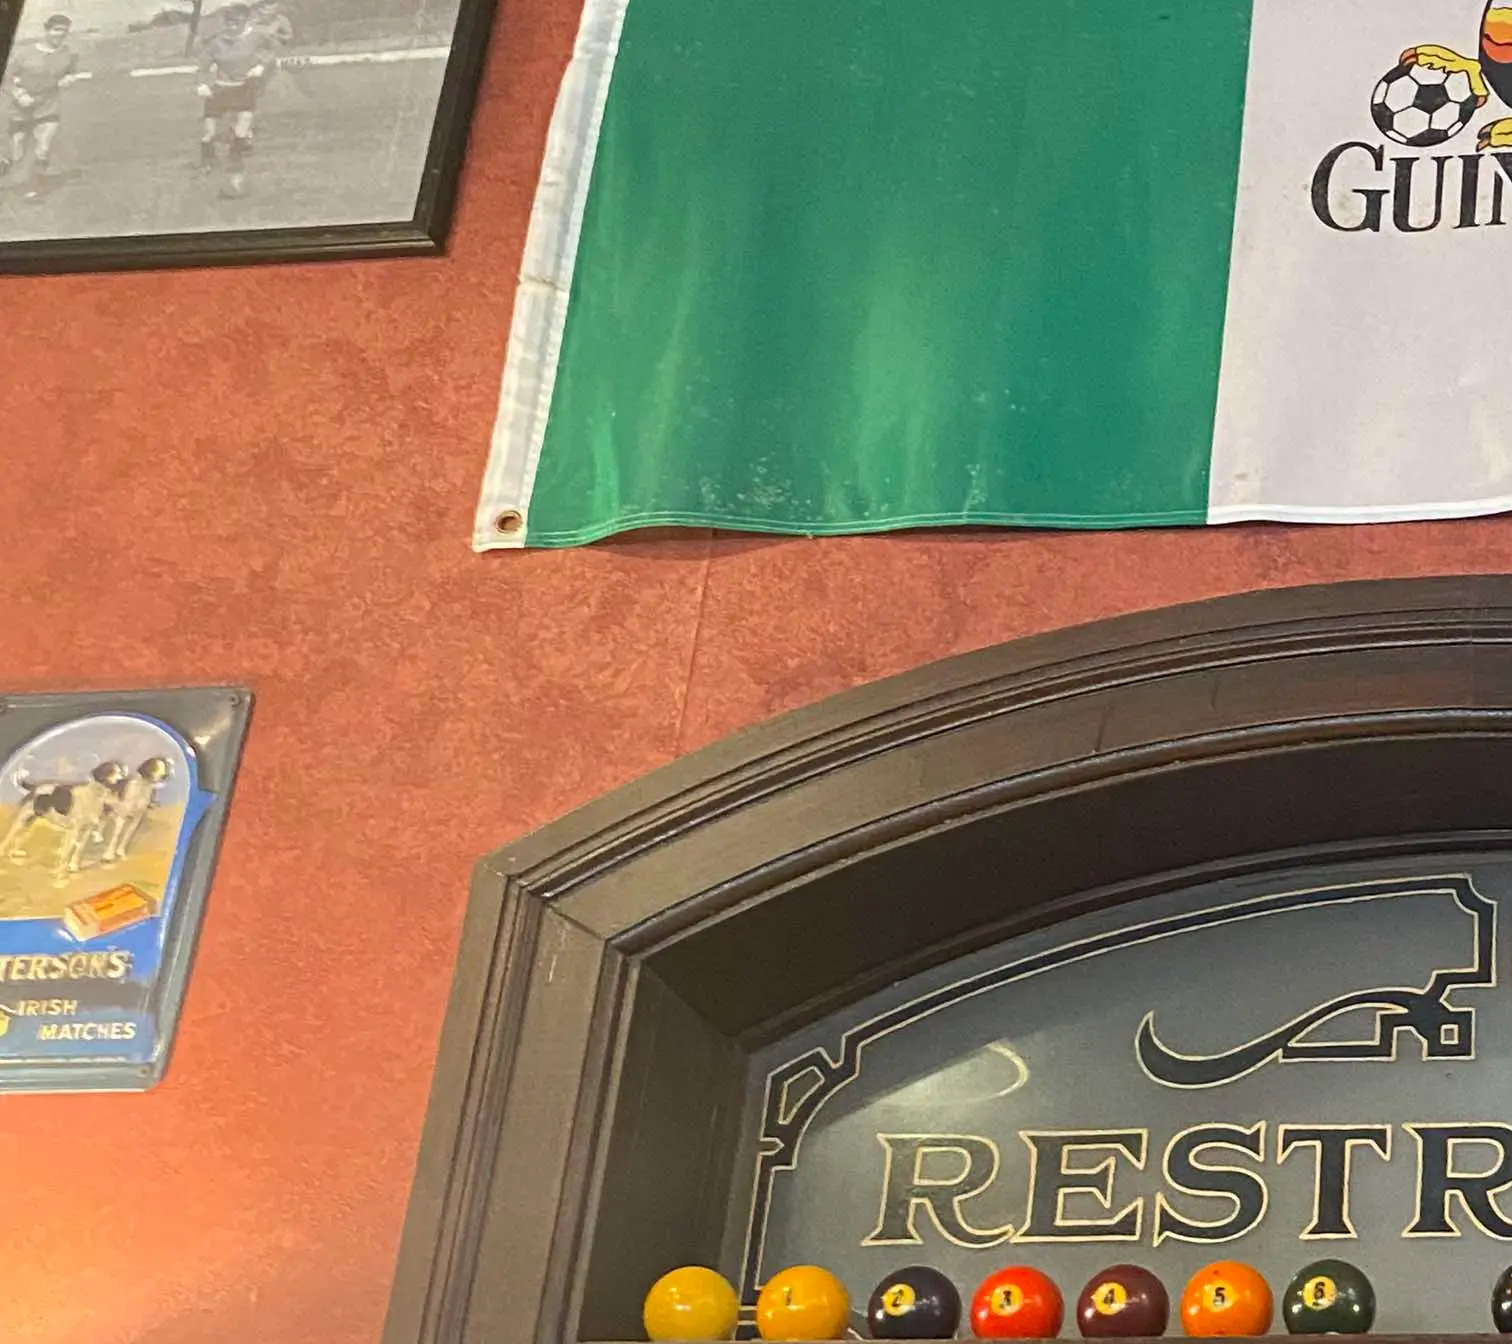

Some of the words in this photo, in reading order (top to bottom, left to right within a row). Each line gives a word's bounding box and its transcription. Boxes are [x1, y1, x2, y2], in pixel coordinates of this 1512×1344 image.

[18, 999, 77, 1016] IRISH
[38, 1022, 137, 1040] MATCHES
[1103, 1287, 1116, 1305] 4
[1212, 1286, 1226, 1304] 5
[1312, 1281, 1326, 1304] 6
